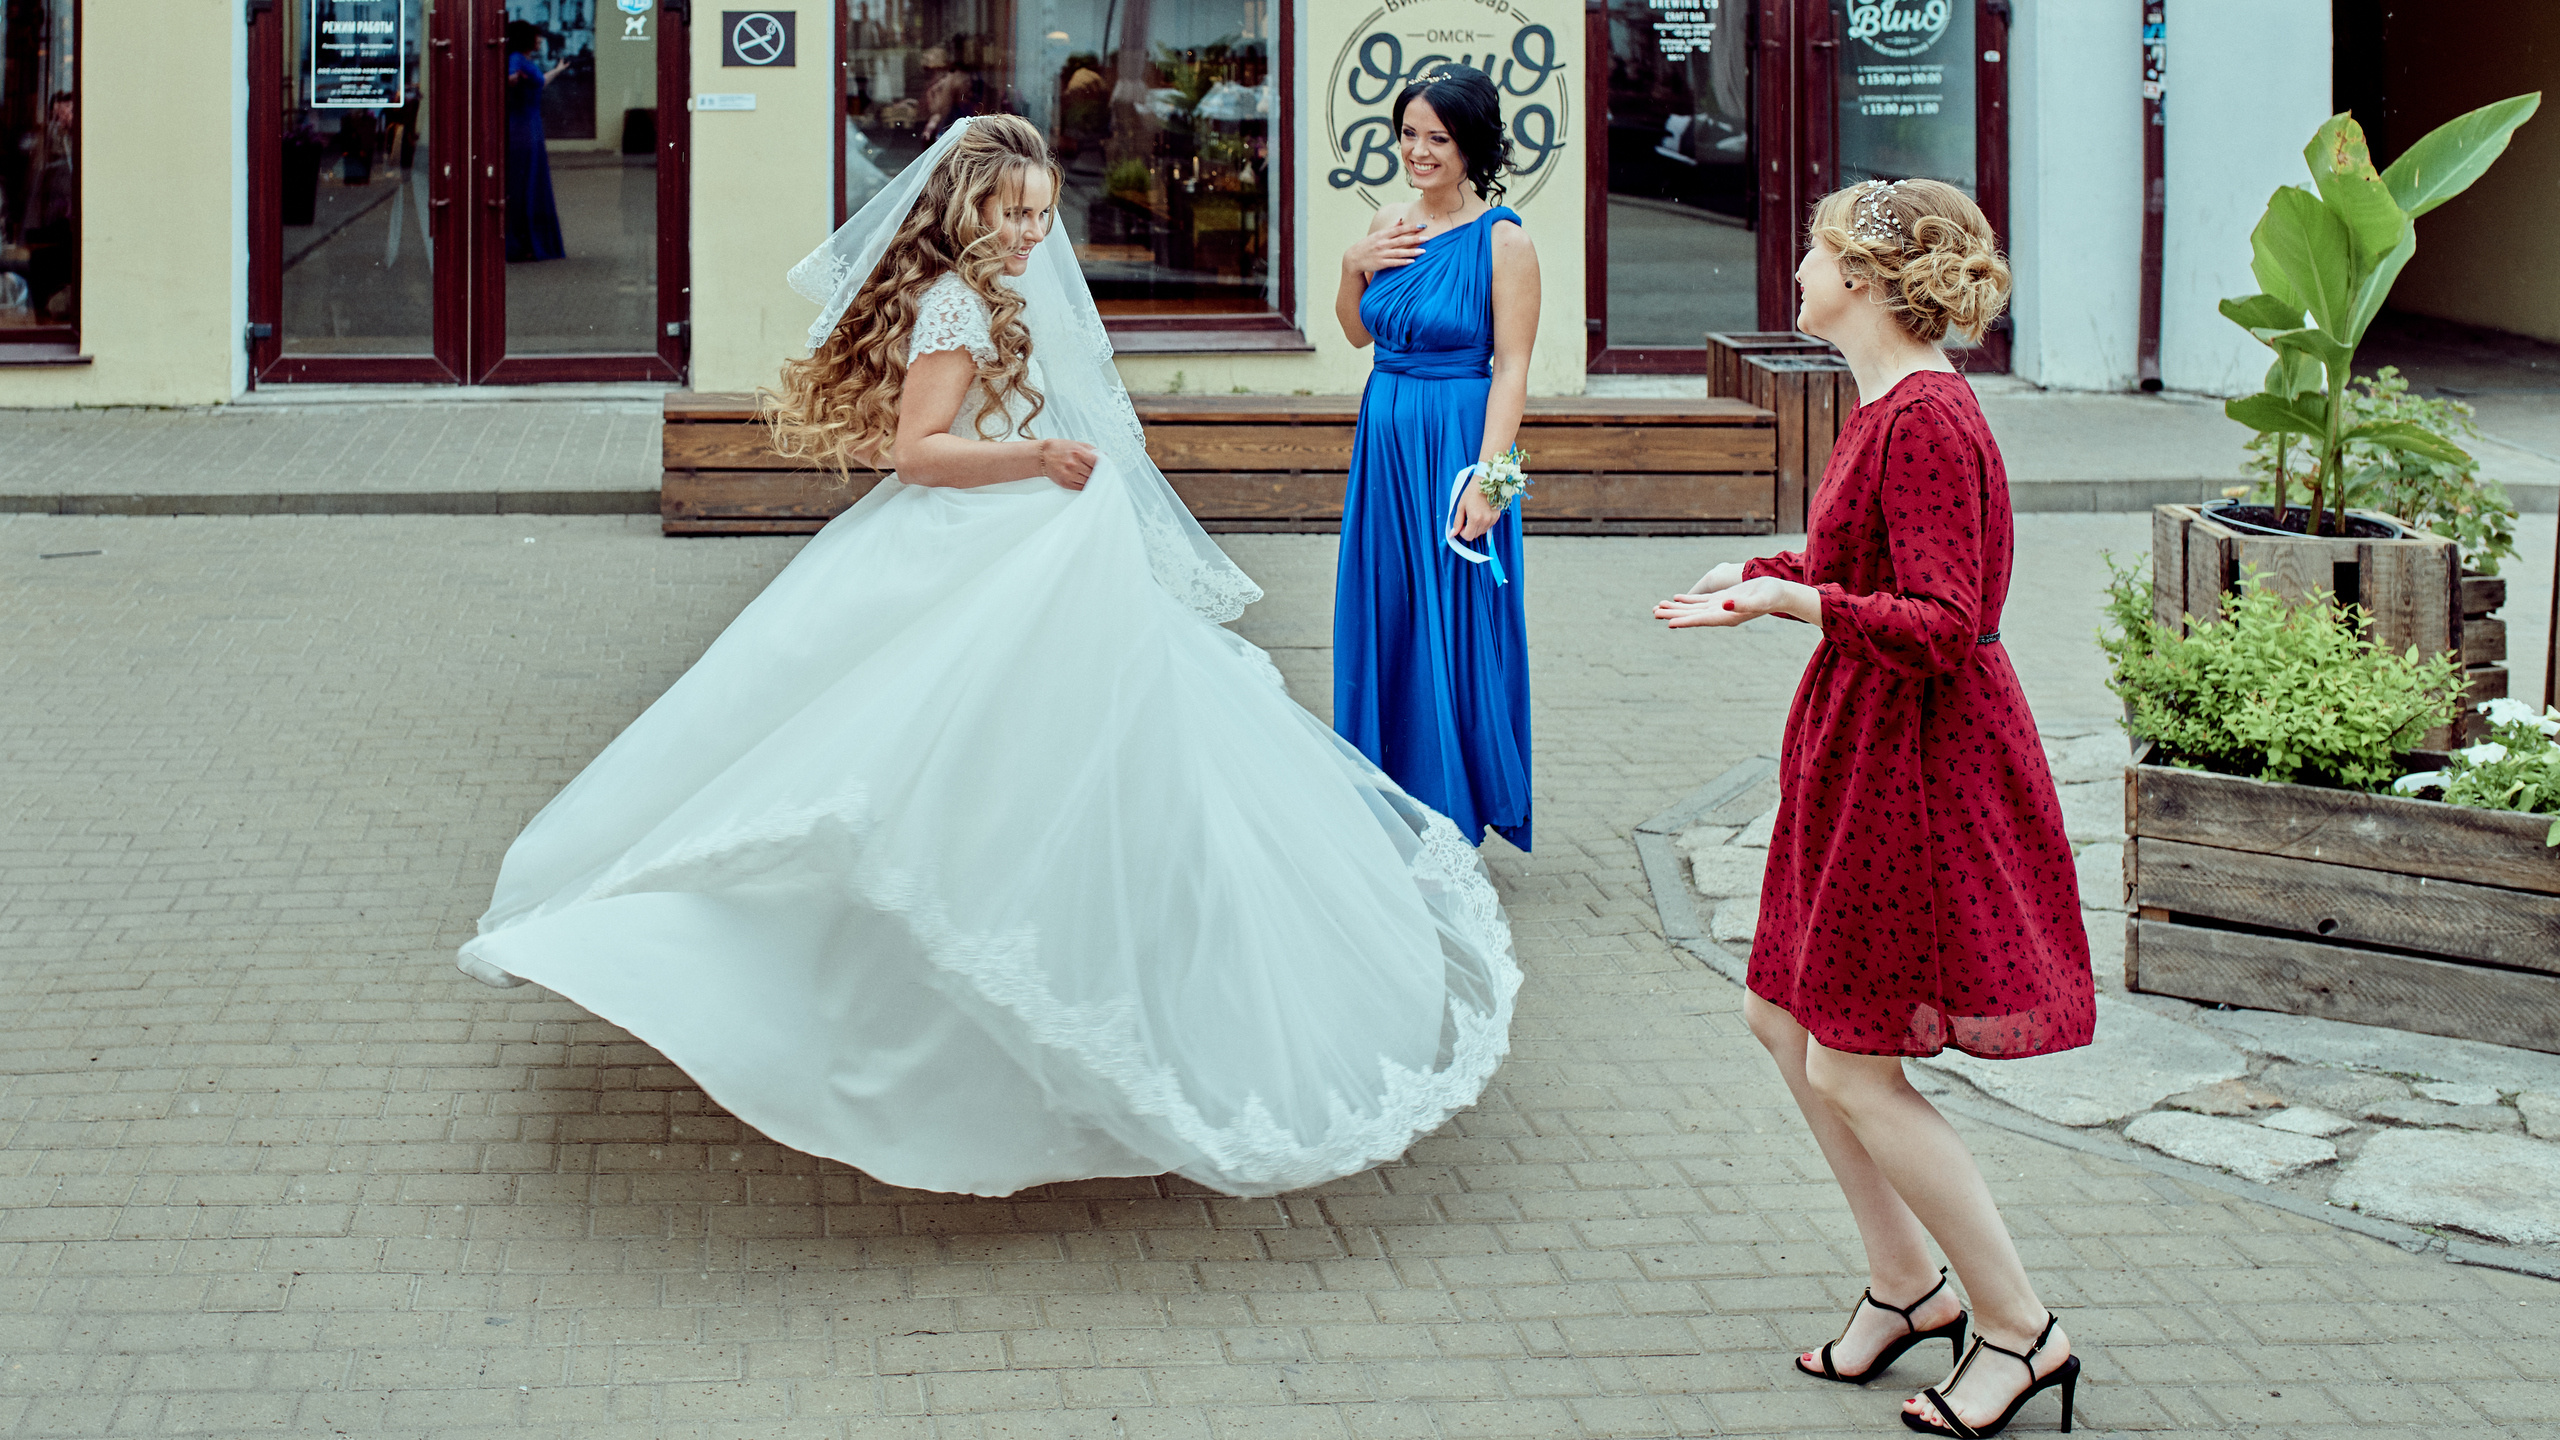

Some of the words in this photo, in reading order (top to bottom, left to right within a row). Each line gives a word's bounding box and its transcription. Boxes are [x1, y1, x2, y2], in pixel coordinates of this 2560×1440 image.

[1664, 11, 1689, 22] CRAFT
[1689, 11, 1706, 22] BAR
[322, 21, 356, 34] РЕЖИМ
[356, 21, 394, 34] РАБОТЫ
[1426, 29, 1475, 43] ОМСК
[1896, 74, 1912, 87] до
[1912, 72, 1943, 85] 00:00
[1899, 104, 1915, 117] до
[1916, 102, 1940, 115] 1:00
